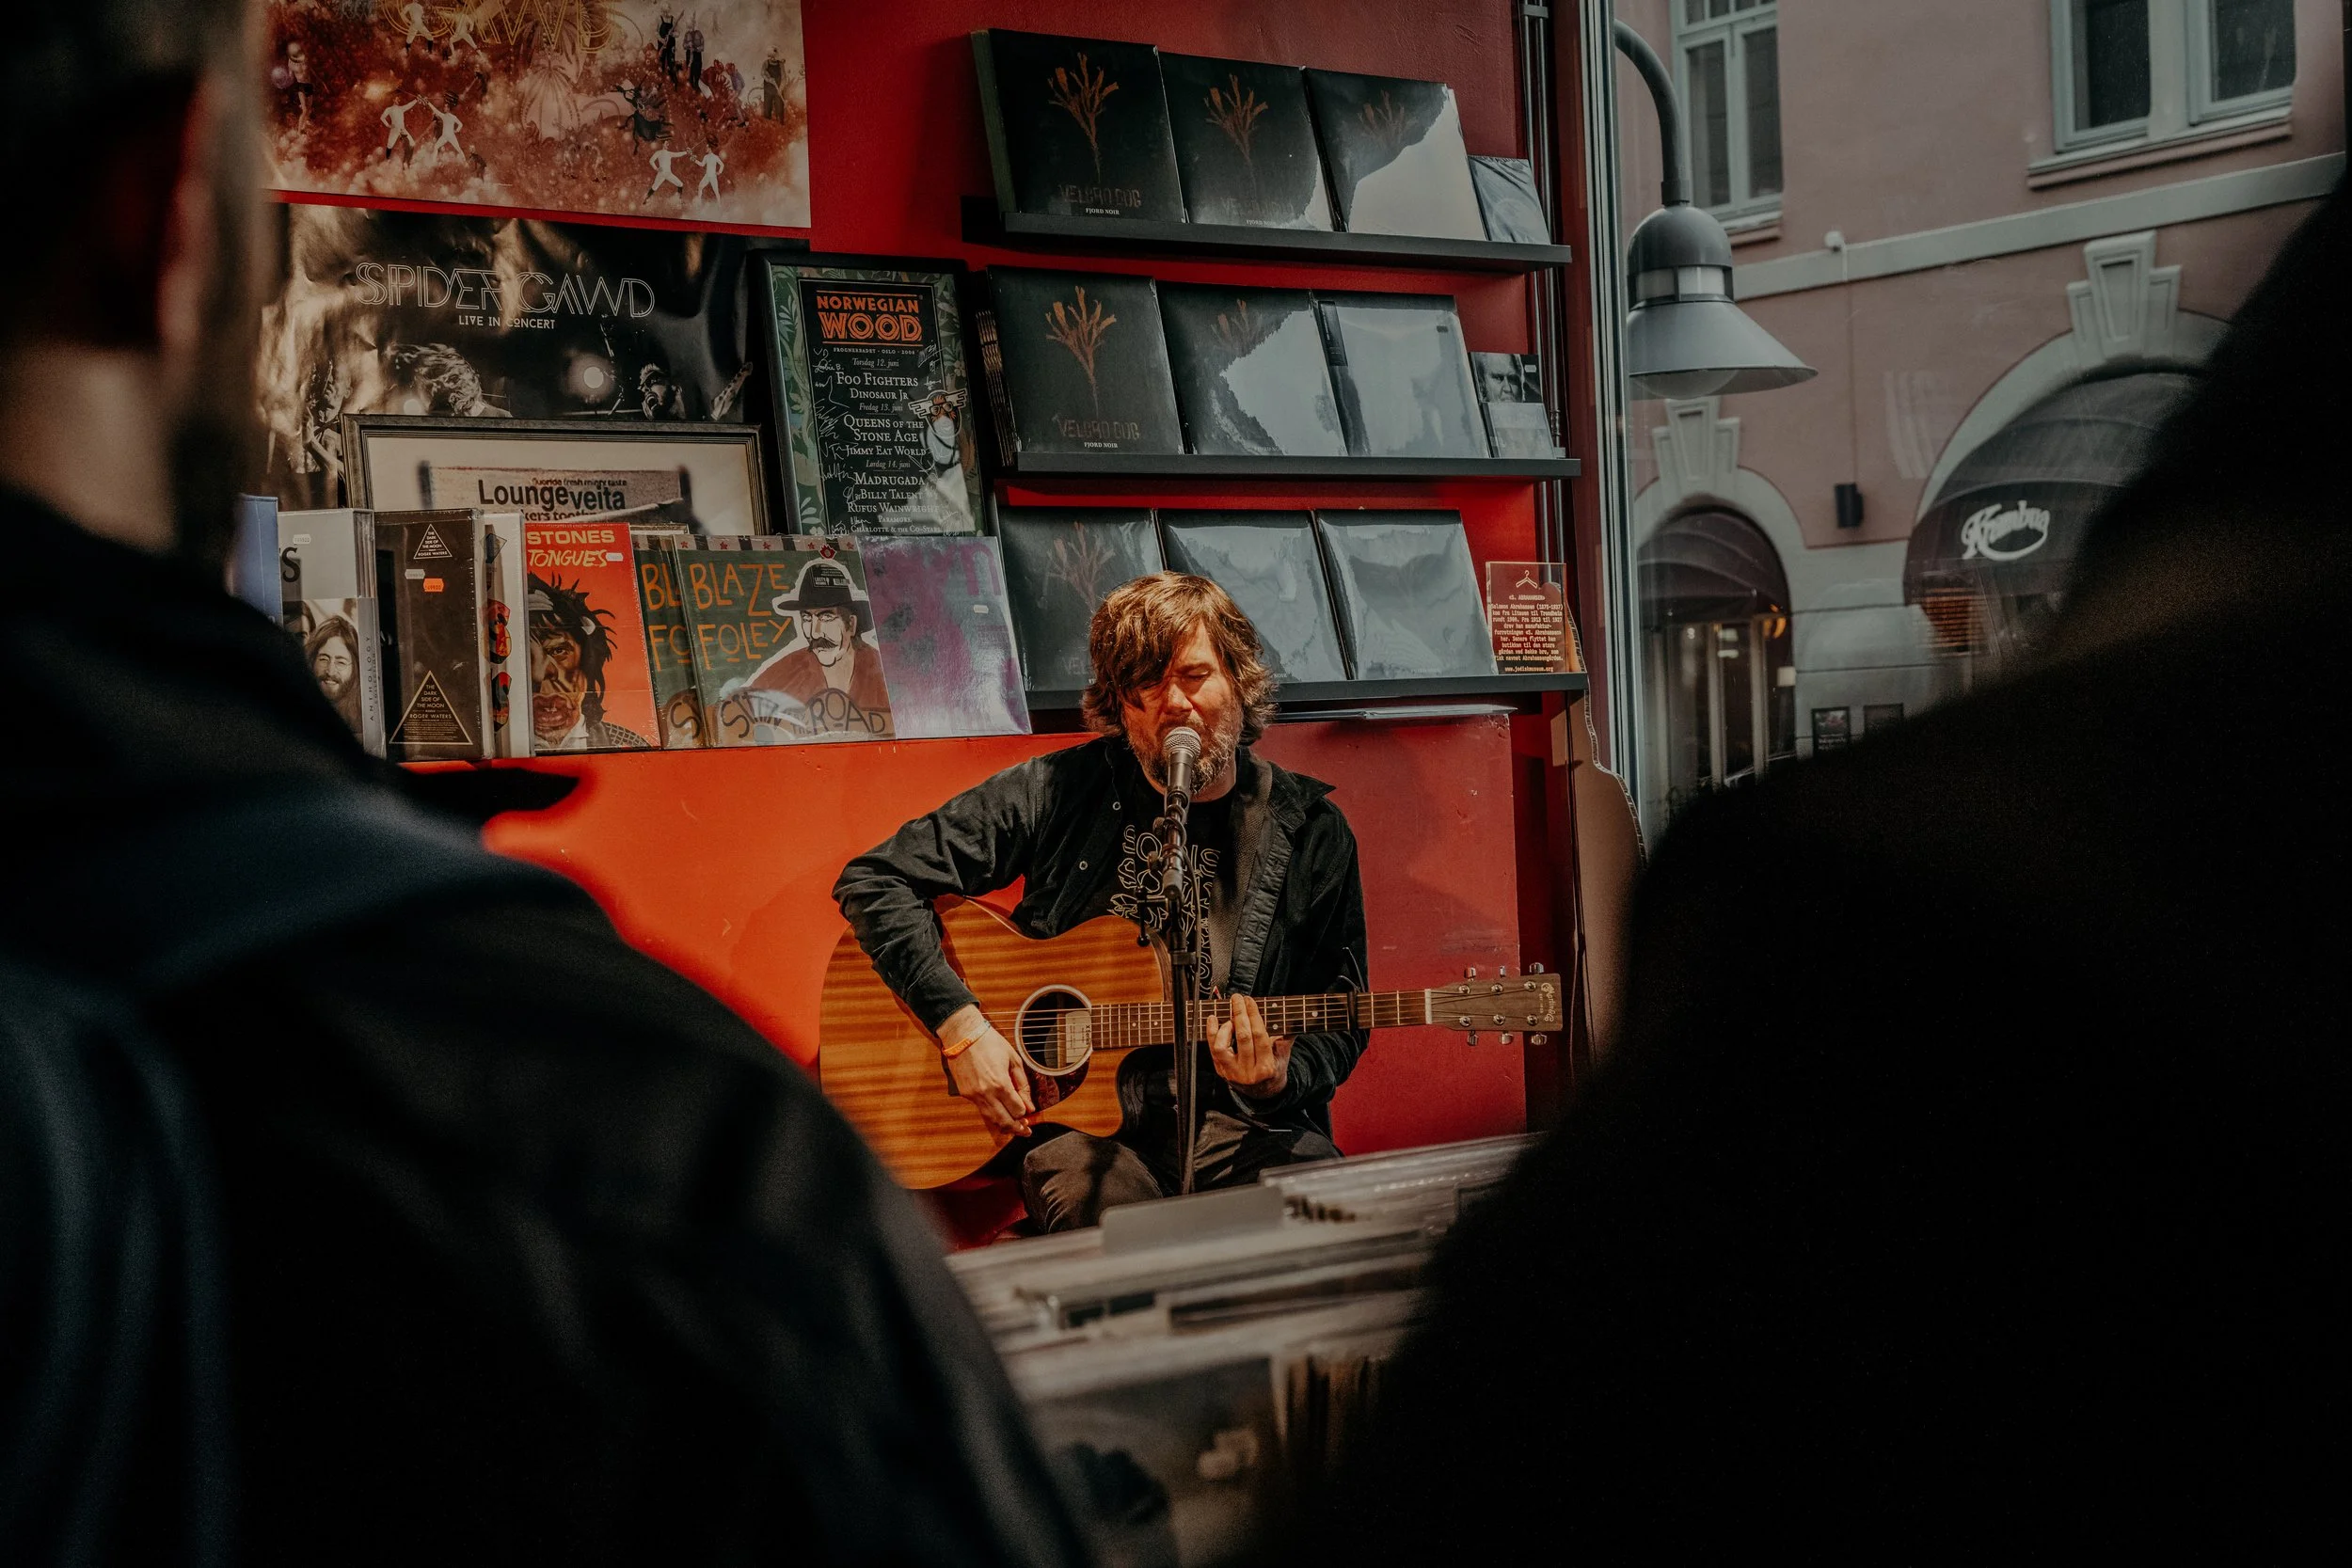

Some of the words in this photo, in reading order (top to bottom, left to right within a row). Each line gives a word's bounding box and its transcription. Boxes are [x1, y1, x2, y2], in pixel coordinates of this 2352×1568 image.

[817, 295, 919, 313] NORWEGIAN
[459, 314, 484, 326] LIVE
[488, 316, 501, 326] IN
[506, 317, 556, 330] CONCERT
[818, 312, 923, 341] WOOD
[852, 357, 875, 369] Torsdag
[877, 358, 886, 367] 12.
[886, 358, 900, 369] juni
[859, 403, 880, 413] Fredag
[881, 404, 890, 412] 13.
[890, 404, 903, 413] juni
[898, 460, 911, 469] juni
[479, 479, 626, 512] Loungeveita
[526, 530, 615, 546] STONES
[528, 549, 608, 568] TONGUES
[689, 562, 791, 617] BLAZE
[697, 617, 792, 670] FOLEY
[366, 636, 374, 721] ANTHOLOGY
[810, 690, 886, 736] ROAD
